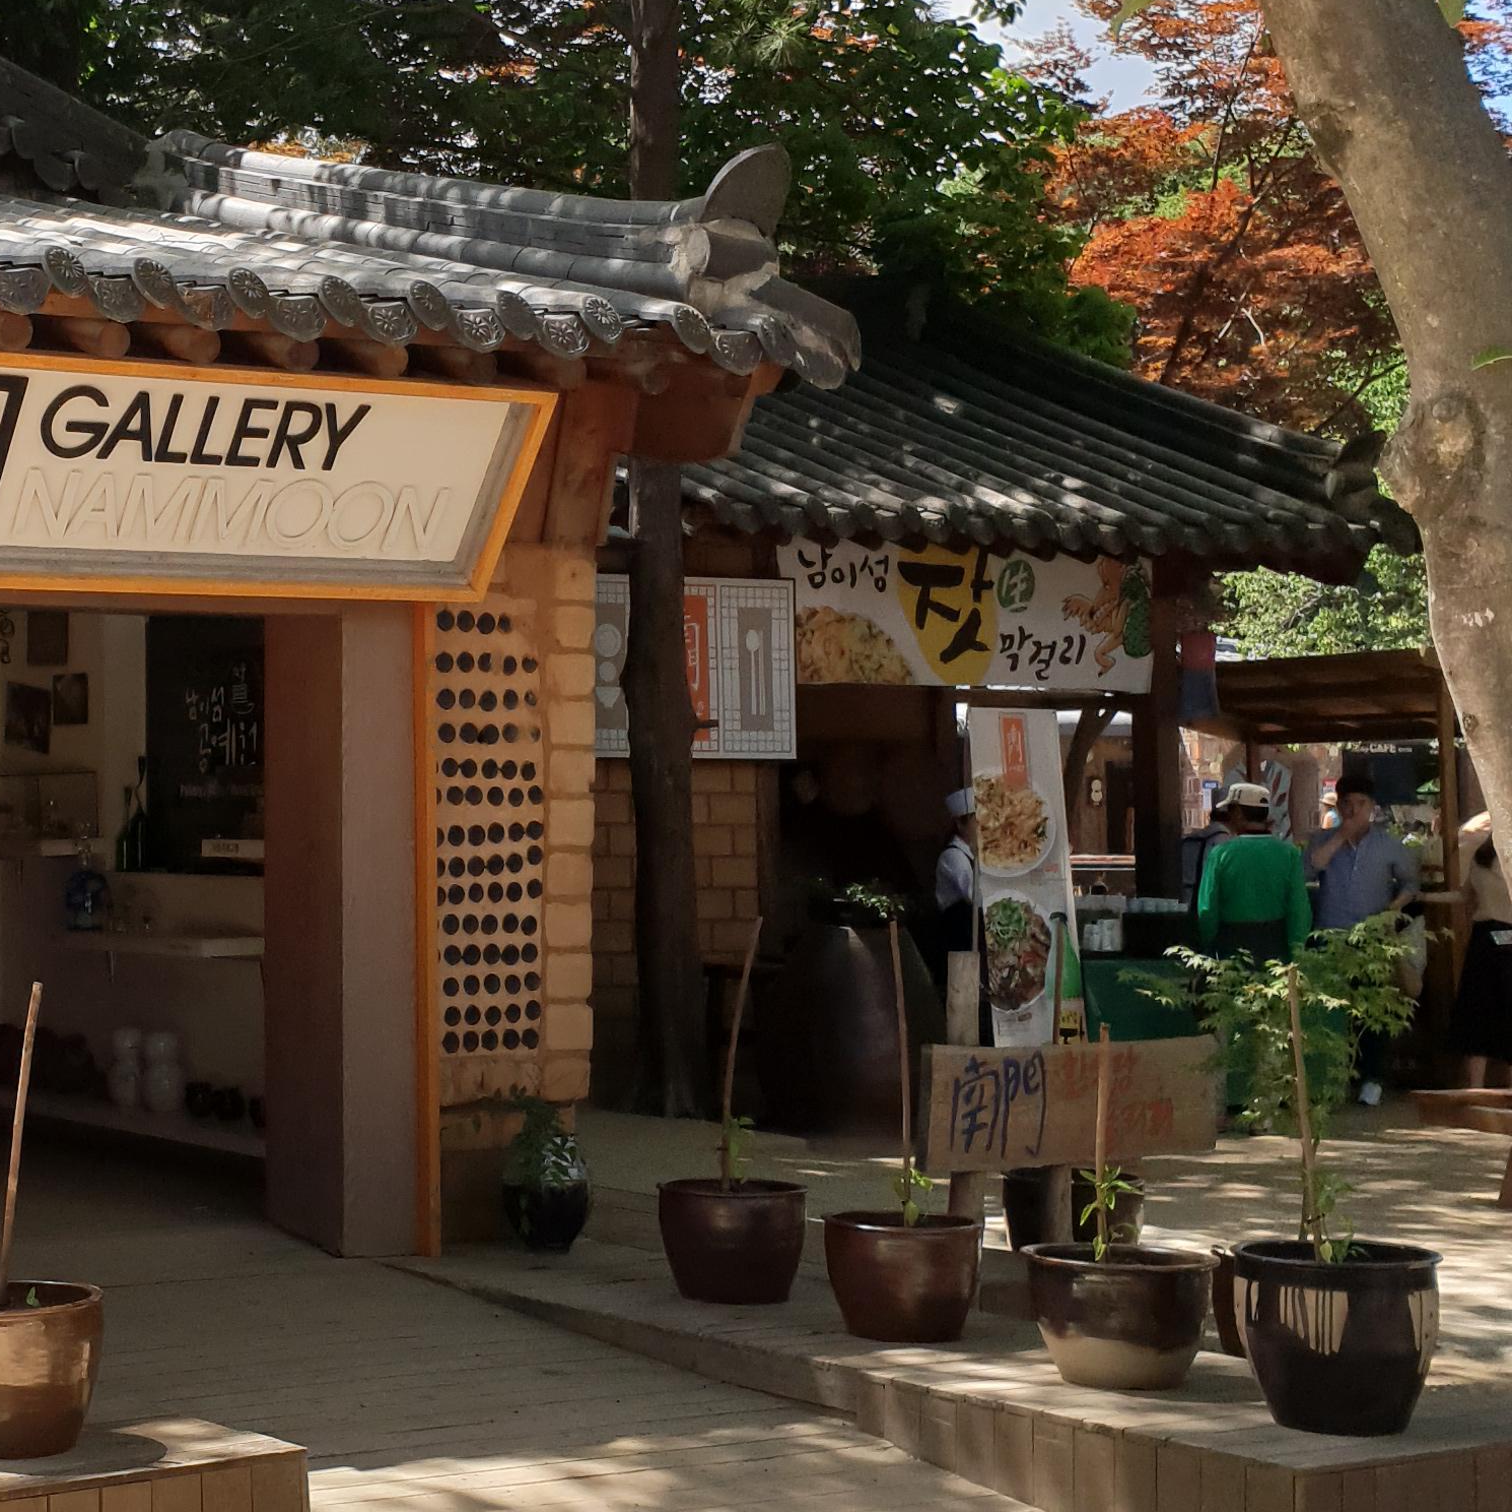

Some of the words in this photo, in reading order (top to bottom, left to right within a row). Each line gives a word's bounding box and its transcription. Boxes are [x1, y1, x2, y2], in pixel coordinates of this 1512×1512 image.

[40, 384, 372, 471] GALLERY
[12, 467, 453, 555] NAMMOON
[999, 626, 1088, 681] 막걸리
